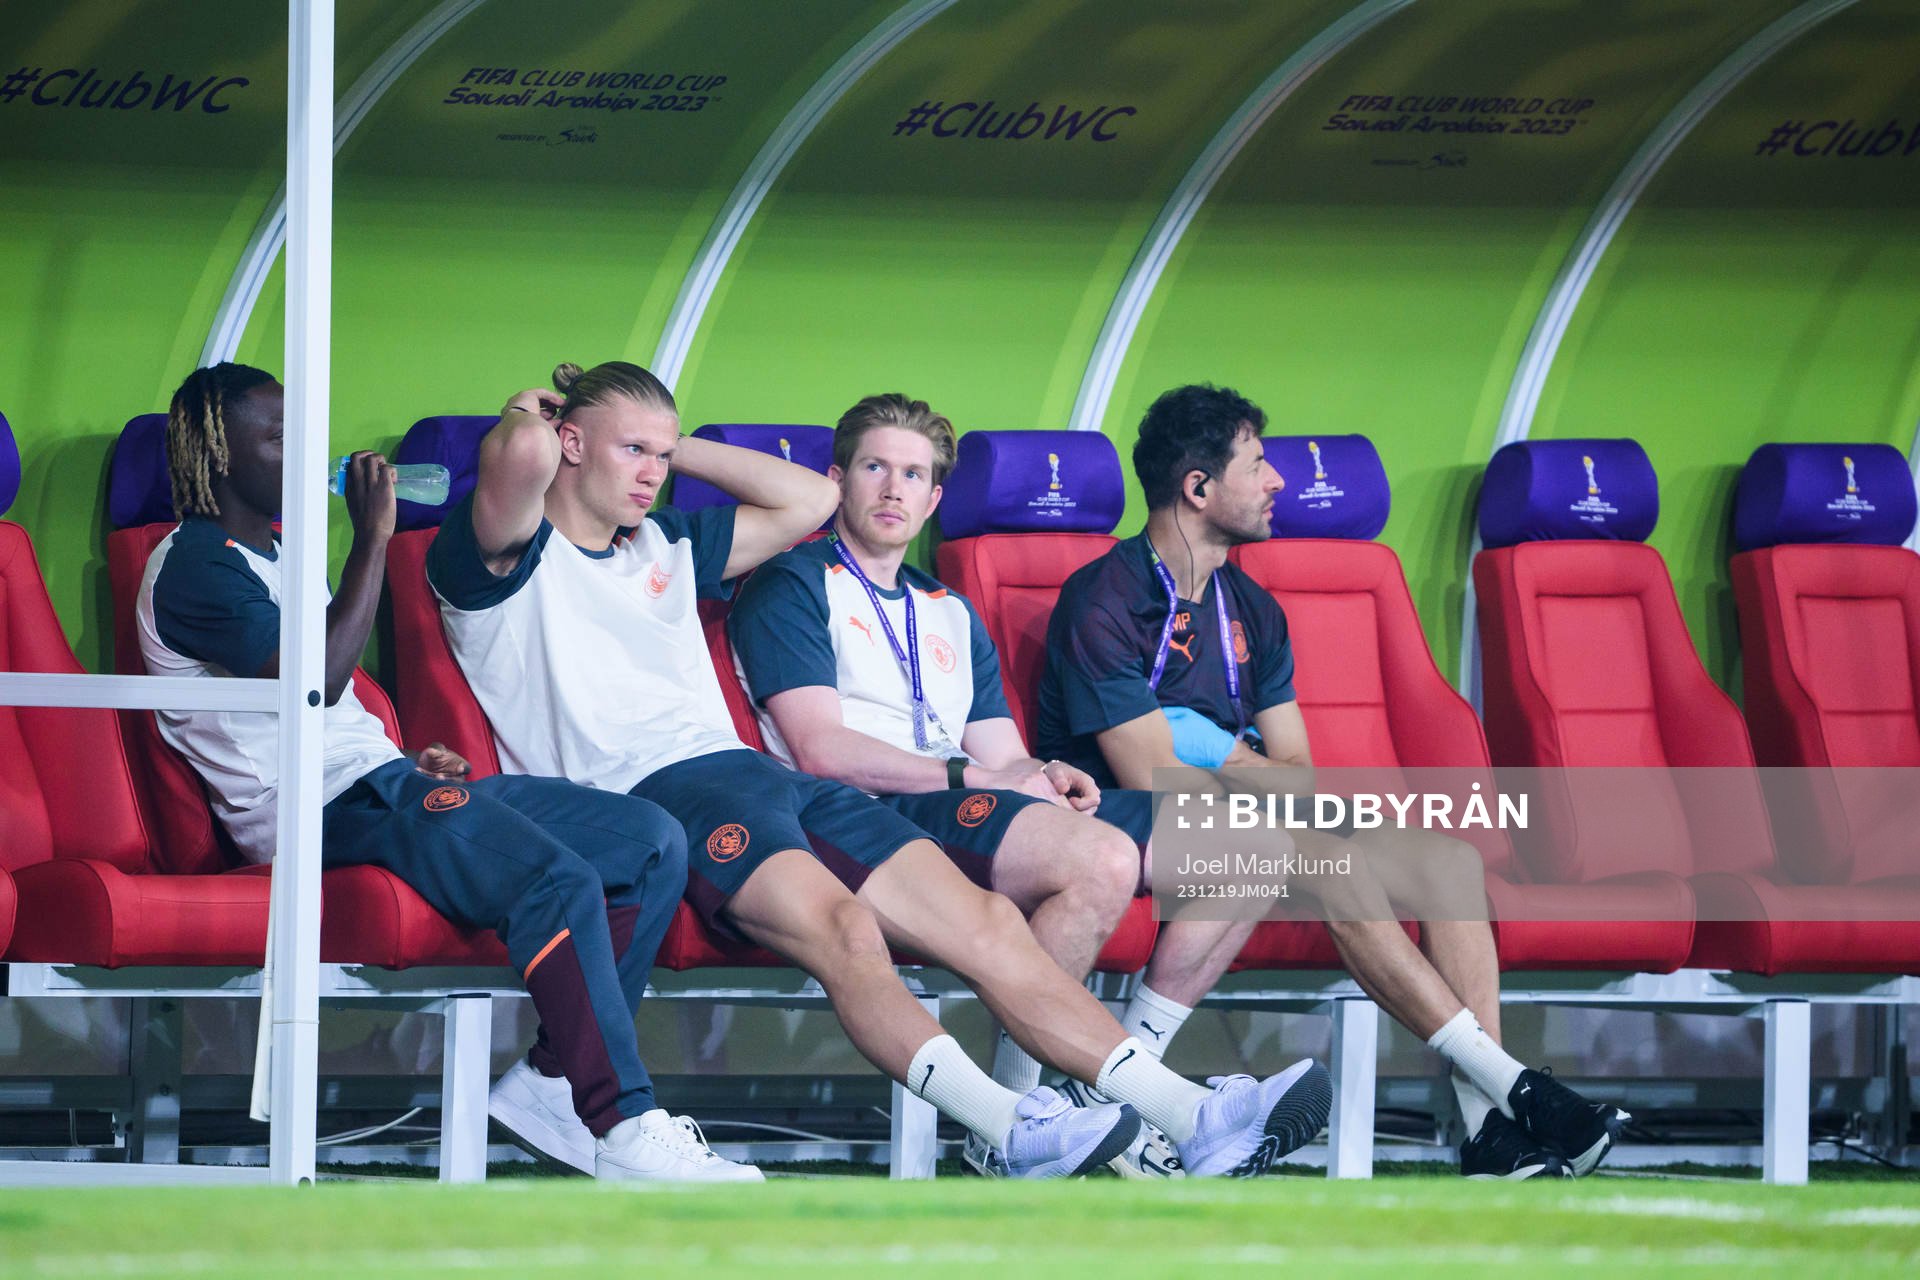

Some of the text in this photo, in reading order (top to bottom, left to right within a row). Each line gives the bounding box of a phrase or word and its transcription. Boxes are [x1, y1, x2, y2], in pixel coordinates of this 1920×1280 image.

[0, 66, 250, 114] #ClubWC
[459, 67, 728, 92] FIFA CLUB WORLD CUP
[443, 87, 536, 106] Saudi
[532, 90, 639, 112] Arabia
[1339, 95, 1595, 114] FIFA CLUB WORLD CUP
[892, 101, 1137, 142] #ClubWC
[1322, 114, 1410, 132] Saudi
[1409, 116, 1509, 134] Arabia
[1755, 119, 1920, 157] #Club
